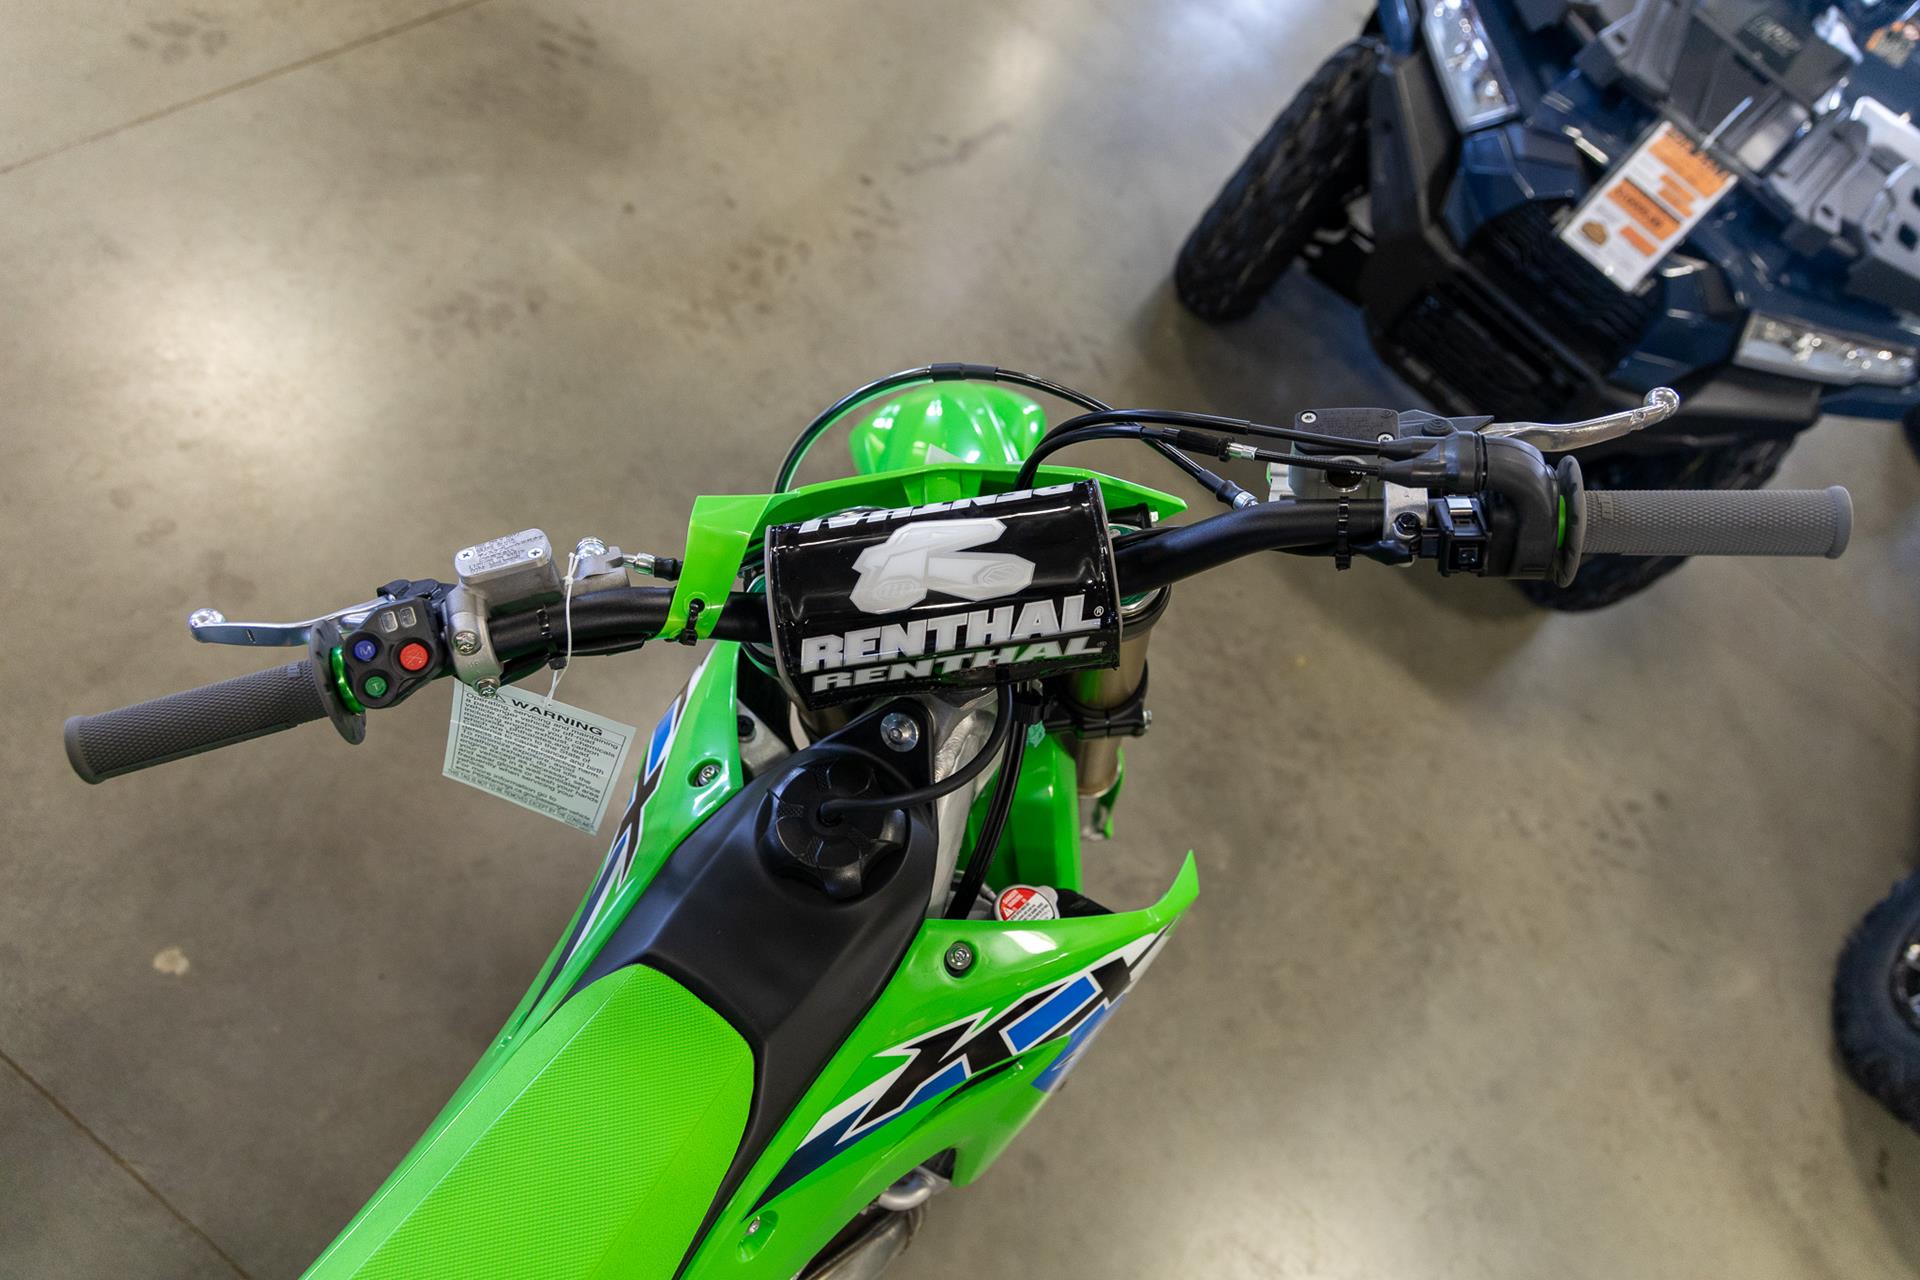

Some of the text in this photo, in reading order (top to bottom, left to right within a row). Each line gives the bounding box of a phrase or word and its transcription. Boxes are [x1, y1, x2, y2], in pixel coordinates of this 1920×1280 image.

[801, 594, 1101, 674] RENTHAL
[812, 637, 1106, 693] RENTHAL
[464, 707, 598, 756] including engine exhaust, carbon
[464, 715, 486, 726] which
[506, 729, 531, 741] known
[544, 742, 557, 751] the
[559, 748, 580, 759] State
[465, 702, 493, 715] vehicle
[497, 713, 512, 721] can
[515, 719, 544, 733] expose
[548, 730, 562, 739] you
[575, 739, 614, 757] chemicals
[466, 692, 617, 749] Operating, servicing and maintaining
[474, 700, 516, 718] passenger
[521, 716, 548, 728] vehicle
[563, 730, 594, 745] off-road
[511, 699, 601, 735] WARNING
[459, 742, 476, 752] your
[480, 749, 505, 761] vehicle
[581, 788, 599, 798] area
[460, 738, 486, 750] engine
[490, 748, 514, 761] except
[573, 780, 599, 793] service
[461, 733, 497, 749] breathing
[548, 764, 561, 772] not
[562, 770, 576, 778] idle
[578, 776, 591, 784] the
[462, 724, 491, 737] defects
[504, 738, 525, 749] other
[528, 747, 575, 768] reproductive
[463, 719, 501, 736] California
[514, 738, 537, 748] cause
[541, 747, 566, 759] cancer
[569, 758, 584, 767] and
[586, 764, 603, 775] birth
[475, 733, 509, 748] minimize
[513, 747, 550, 764] exposure,
[553, 762, 575, 773] avoid
[456, 760, 468, 768] For
[471, 765, 491, 776] more
[494, 774, 535, 793] information
[458, 746, 473, 755] and
[475, 753, 494, 762] wear
[497, 760, 521, 773] gloves
[534, 774, 555, 785] wash
[556, 783, 573, 793] your
[575, 790, 598, 803] hands
[458, 751, 573, 798] frequently when servicing your
